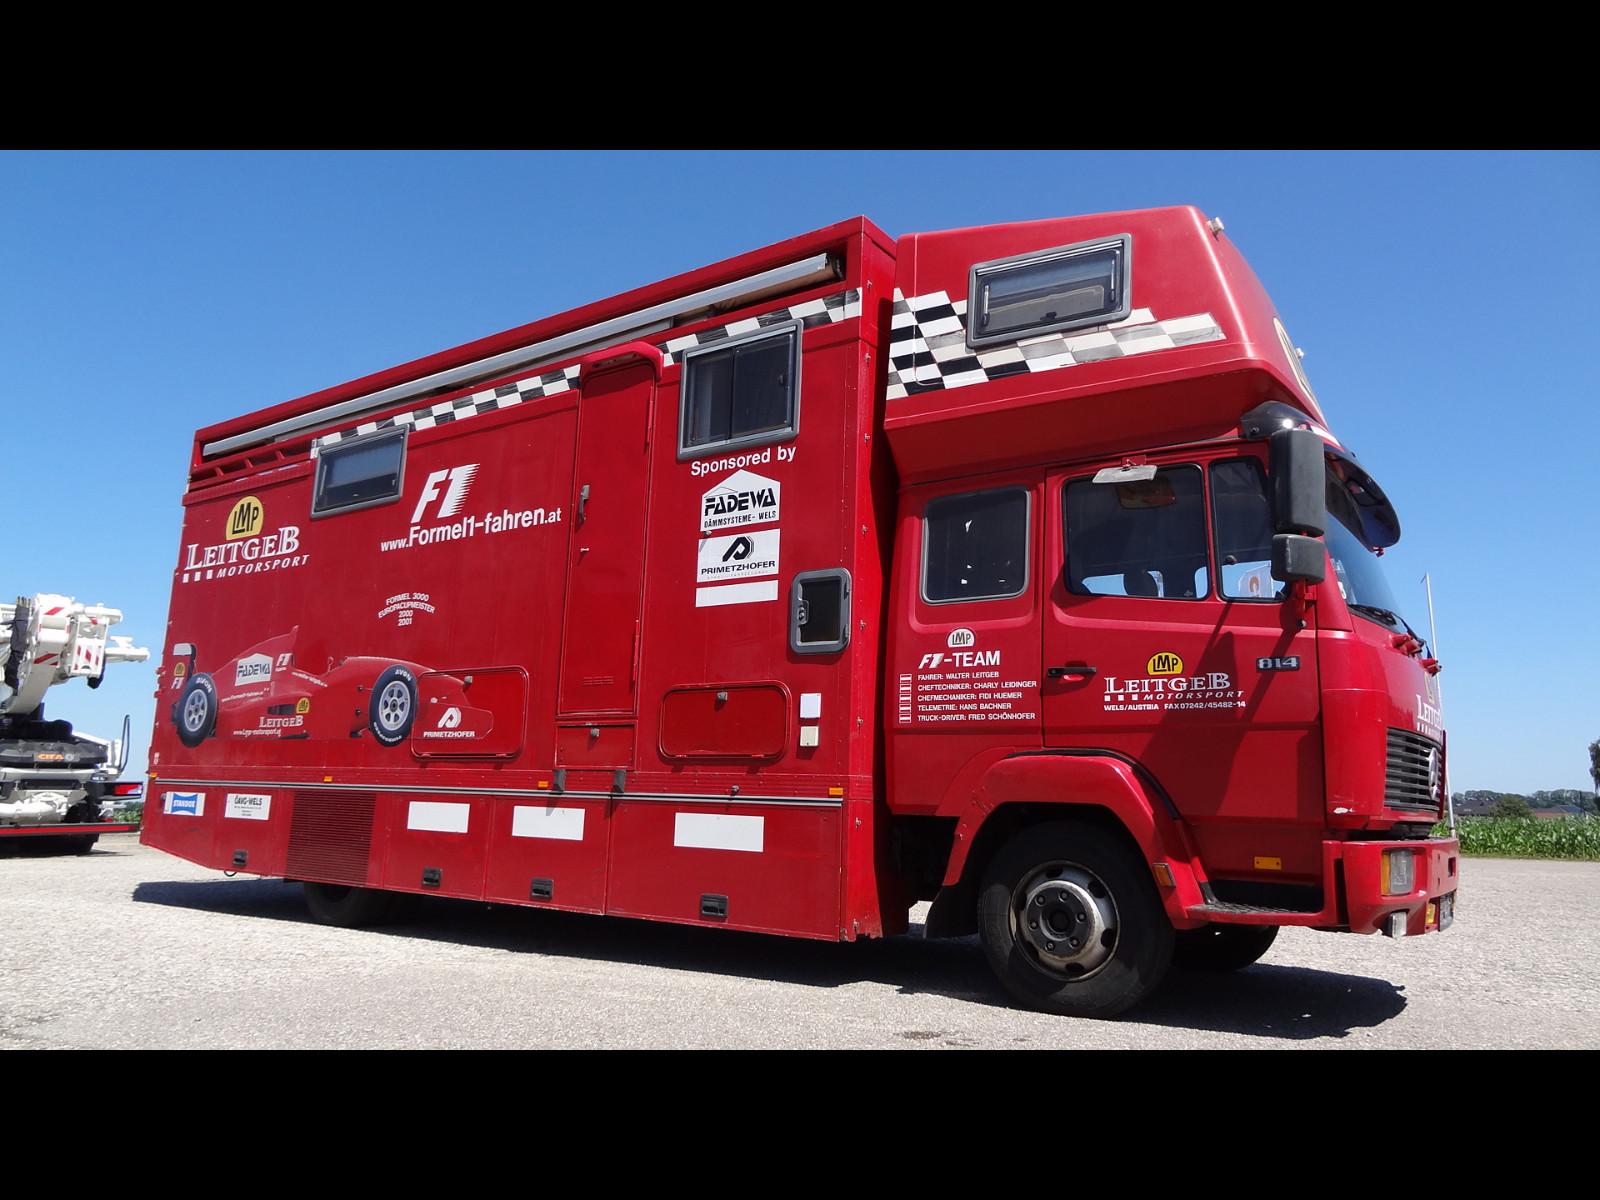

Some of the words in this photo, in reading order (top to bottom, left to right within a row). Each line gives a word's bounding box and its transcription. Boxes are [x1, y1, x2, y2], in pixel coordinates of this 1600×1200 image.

[691, 449, 770, 477] Sponsored
[777, 446, 796, 462] by
[411, 464, 480, 523] F1
[704, 487, 777, 517] FADEWA
[232, 502, 259, 534] LMP
[758, 510, 777, 520] WELS
[381, 508, 561, 551] www.Formel1-fahren.at
[184, 526, 300, 571] LEITGEB
[217, 554, 310, 579] MOTORSPORT
[701, 560, 776, 575] PRIMETZHOFER
[386, 593, 411, 605] FORMEL
[412, 592, 429, 602] 3000
[398, 610, 413, 618] 2000
[398, 617, 412, 626] 2001
[952, 632, 972, 645] LMP
[918, 650, 1001, 669] F1-TEAM
[1153, 655, 1179, 672] LMP
[1259, 657, 1298, 669] 814
[395, 669, 411, 681] AVON
[918, 673, 944, 681] FAHRER:
[945, 672, 970, 680] WALTER
[918, 683, 972, 691] CHEFTECHNIKER:
[1001, 681, 1037, 689] LEIDINGER
[1104, 672, 1231, 694] LEITGEB
[918, 693, 977, 702] CHEFMECHANIKER:
[993, 691, 1022, 699] HUEMER
[1143, 690, 1244, 701] MOTORSPORT
[979, 702, 1012, 710] BACHNER
[1104, 703, 1160, 711] WELS/AUSTRIA
[918, 714, 967, 722] TRUCK-DRIVER:
[968, 713, 986, 721] FRED
[988, 711, 1036, 720] SCHÖNHOFER
[423, 731, 475, 739] PRIMETZHOFER
